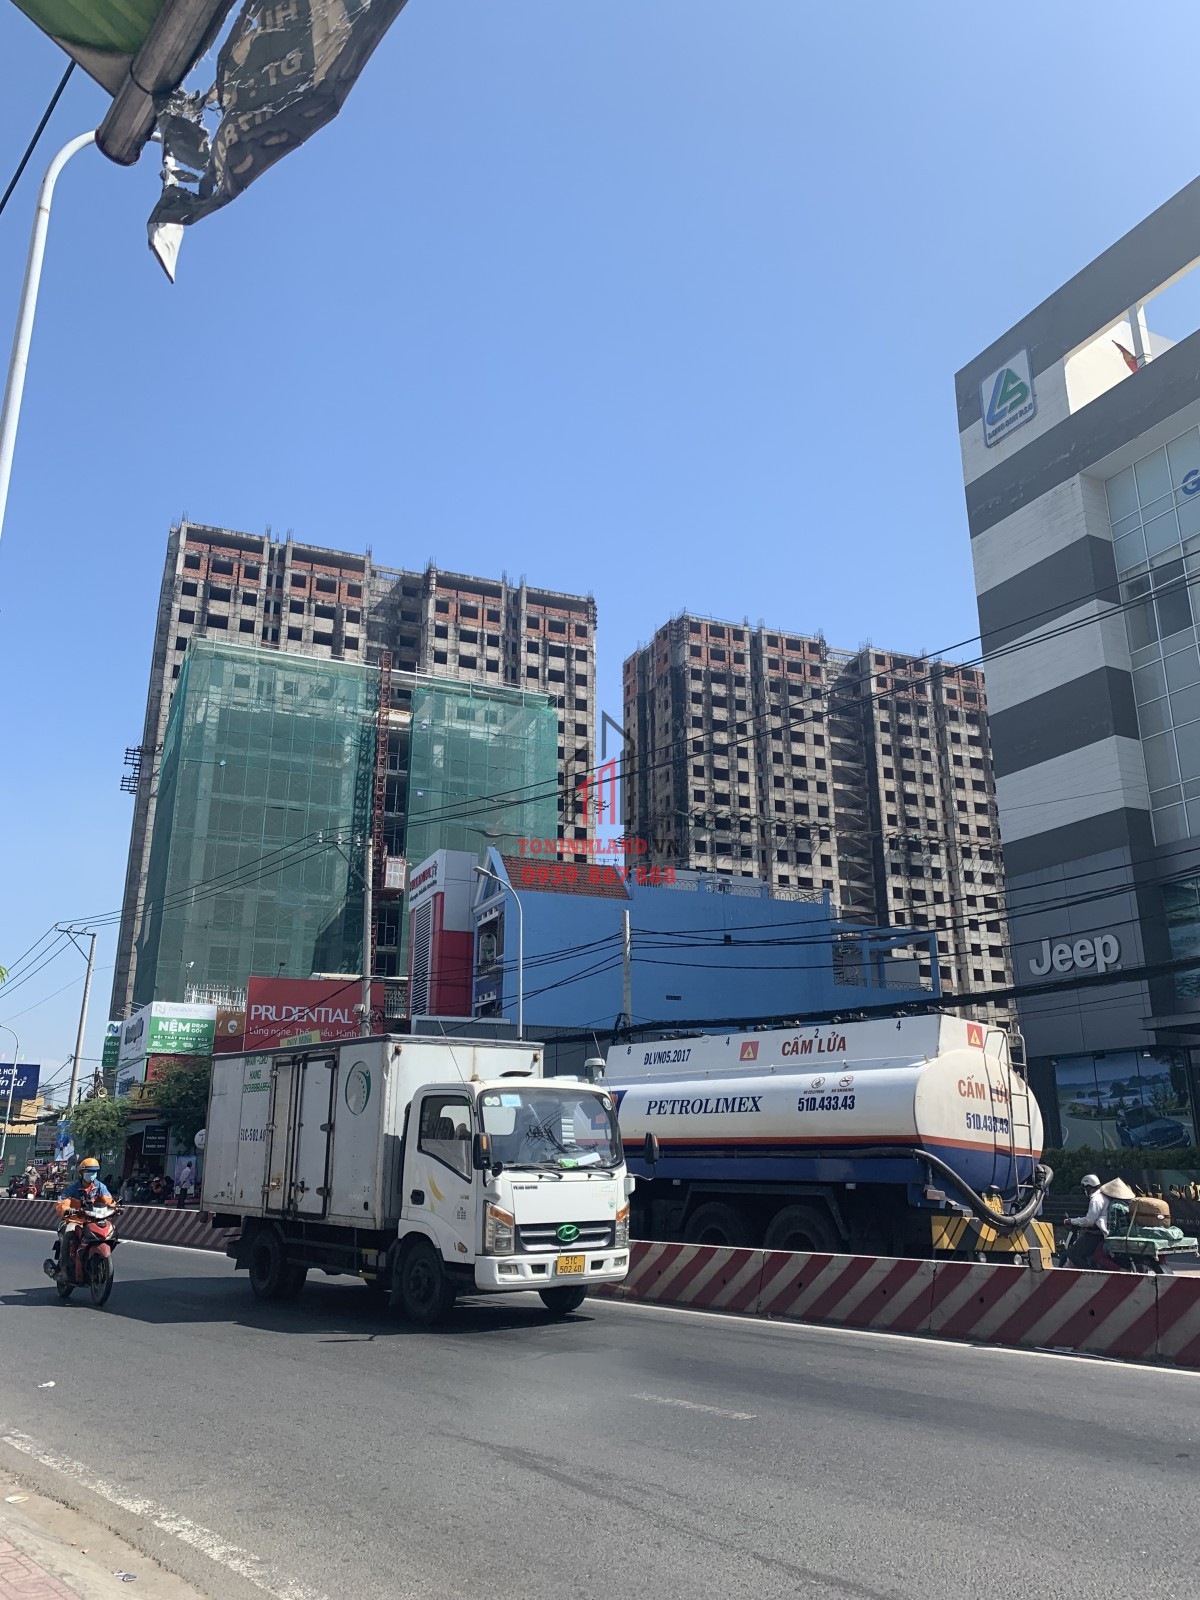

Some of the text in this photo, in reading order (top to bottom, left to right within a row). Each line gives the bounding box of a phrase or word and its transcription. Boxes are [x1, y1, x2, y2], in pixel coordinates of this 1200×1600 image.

[1029, 934, 1119, 976] Jeep
[250, 1004, 352, 1024] PRUDENTIAL
[158, 1019, 190, 1034] NỆM
[781, 1031, 847, 1056] CẤM LỬA
[957, 1075, 986, 1101] CẤM
[645, 1095, 763, 1116] PETROLIMEX
[798, 1095, 856, 1112] 51D.433.43
[966, 1112, 1009, 1134] 51D.433.43
[559, 1264, 582, 1273] 502.40
[565, 1256, 578, 1265] 51C
